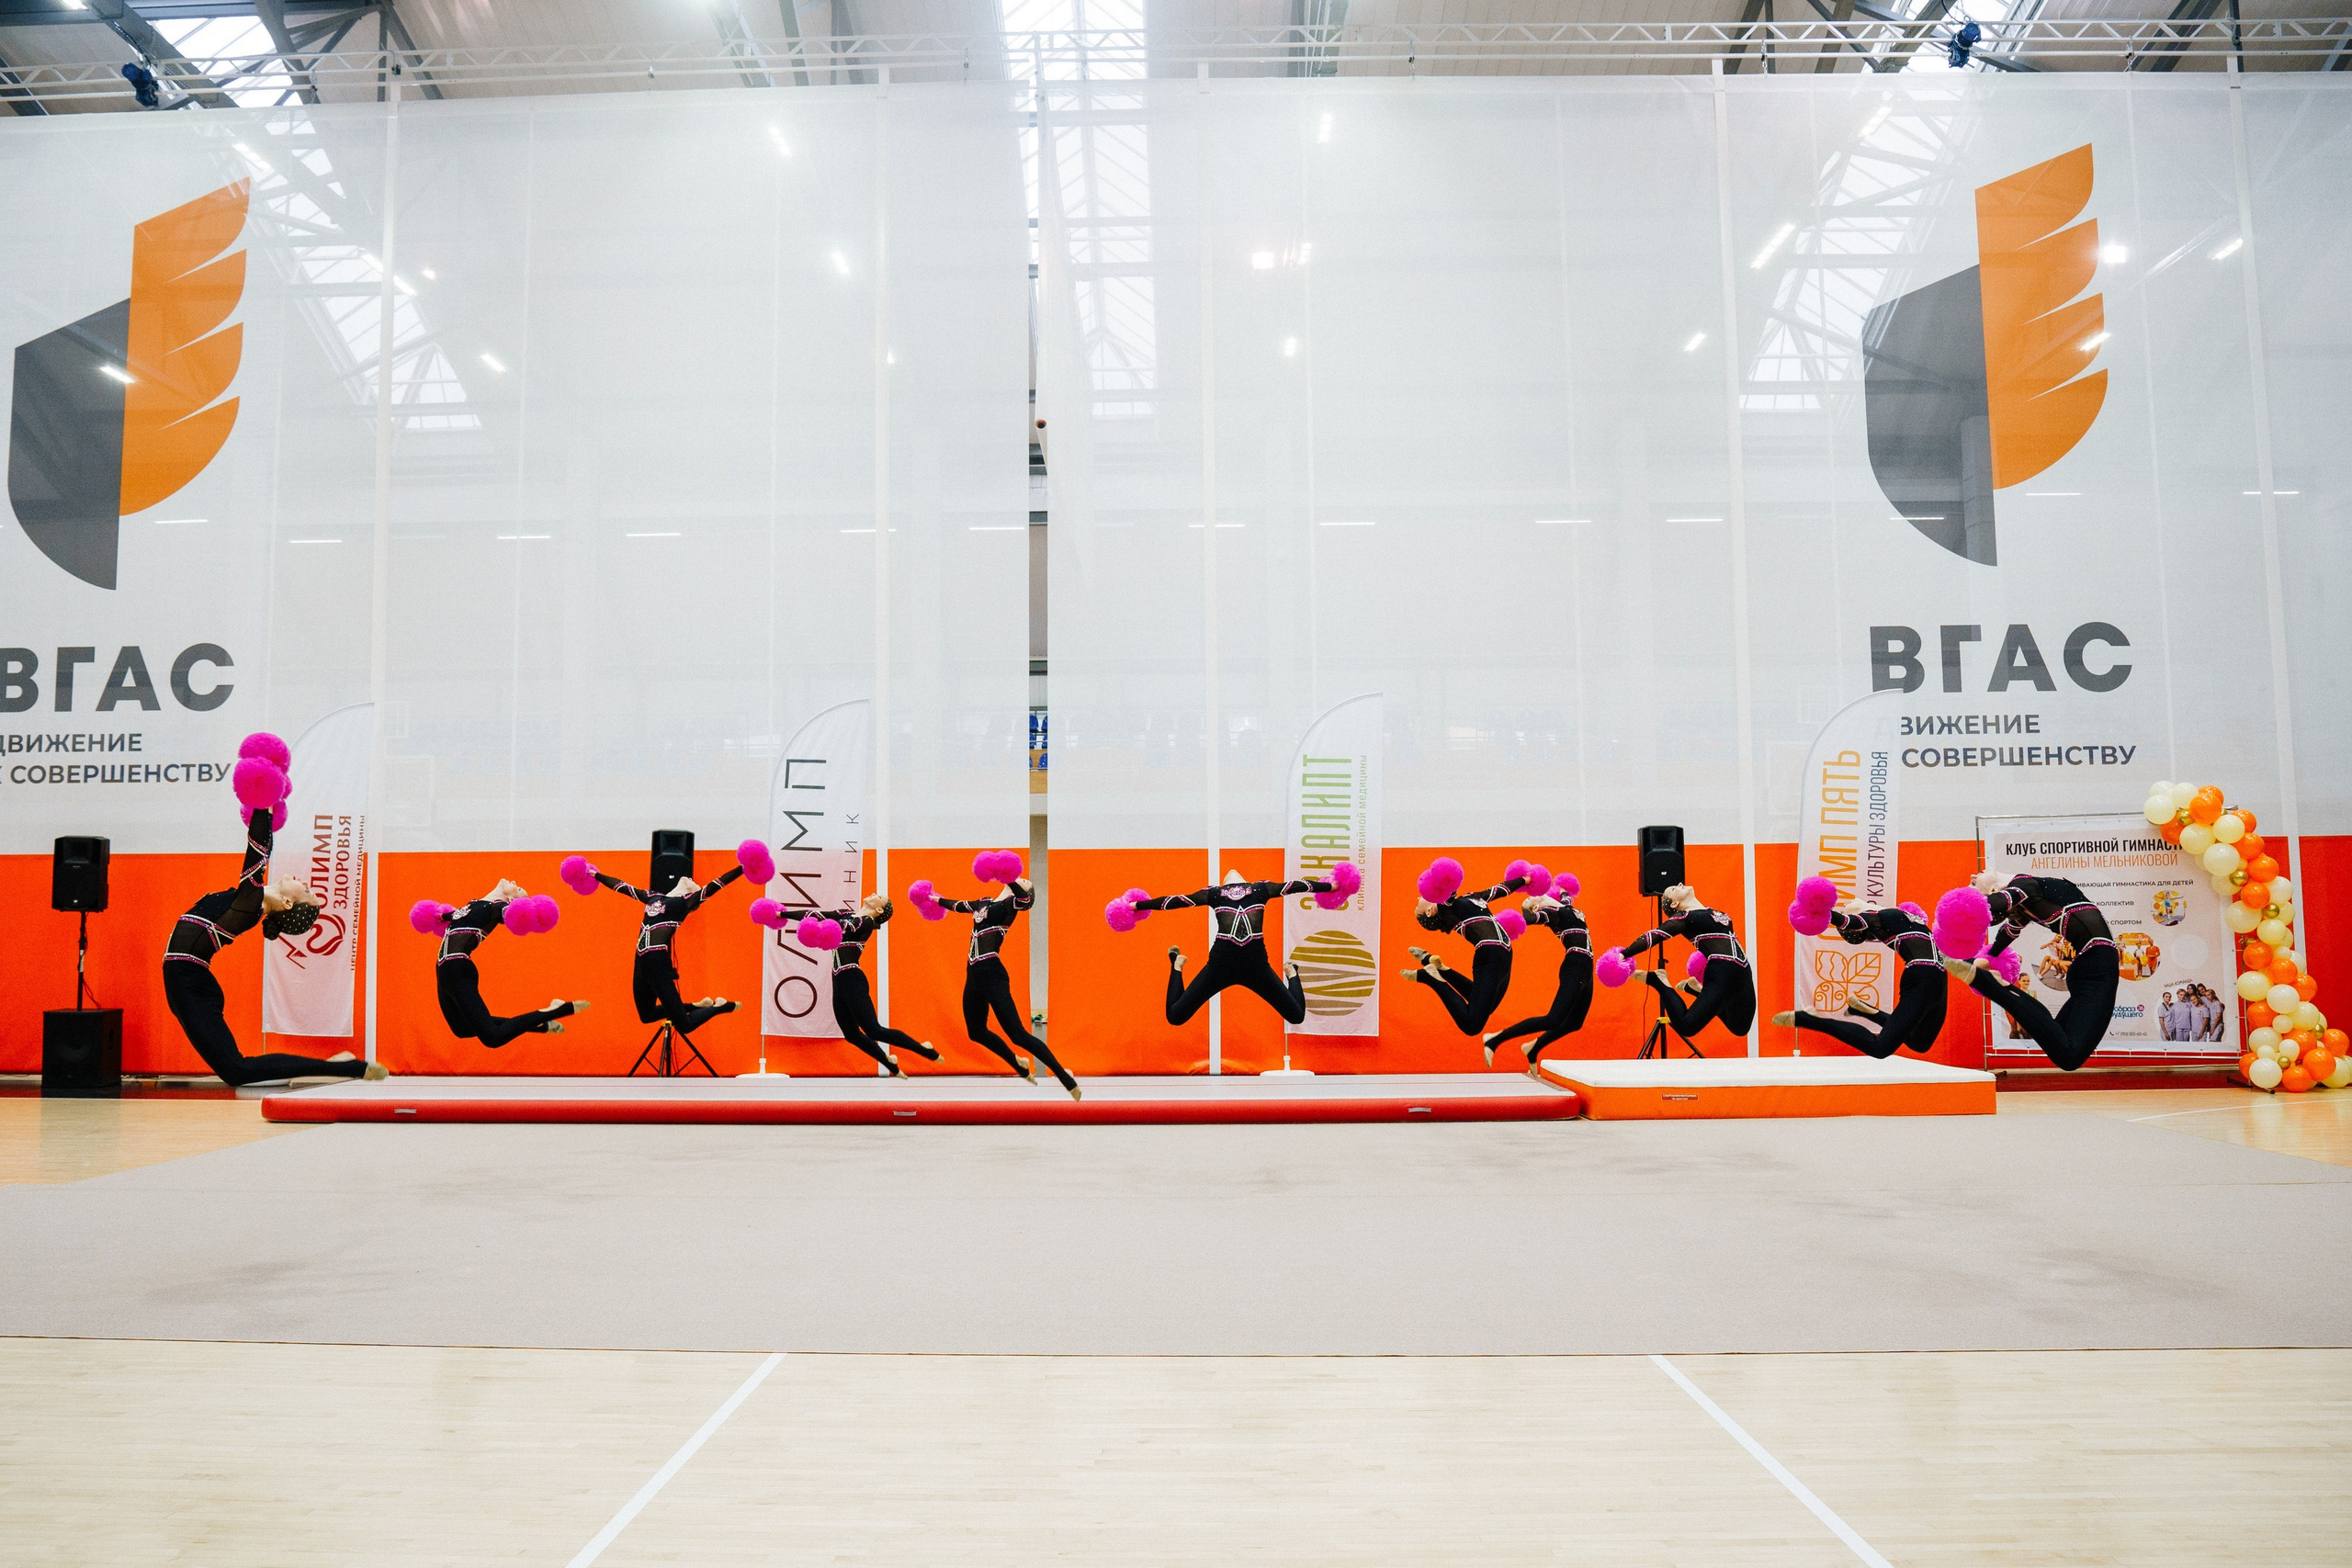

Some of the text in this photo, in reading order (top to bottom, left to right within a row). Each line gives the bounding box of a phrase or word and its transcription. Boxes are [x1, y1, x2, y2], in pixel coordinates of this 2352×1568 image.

[0, 643, 235, 713] ВГАС
[1870, 622, 2132, 694] ВГАС
[1901, 714, 2041, 735] ВИЖЕНИЕ
[1902, 745, 2137, 768] СОВЕРШЕНСТВУ
[10, 762, 232, 784] СОВЕРШЕНСТВУ
[1358, 754, 1367, 809] медицины
[1821, 750, 1860, 825] ПЯТЬ
[1869, 751, 1888, 820] ЗДОРОВЬЯ
[334, 815, 353, 909] ЗДОРОВЬЯ
[842, 814, 859, 912] ИНИК
[1356, 813, 1366, 864] семейной
[1867, 823, 1885, 897] КУЛЬТУРЫ
[2006, 843, 2037, 857] КЛУБ
[2040, 837, 2119, 854] СПОРТИВНОЙ
[2031, 851, 2177, 869] АНГЕЛИНЫ МЕЛЬНИКОВОЙ
[353, 878, 361, 936] СЕМЕЙНОЙ
[357, 815, 366, 876] МЕДИЦИНЫ
